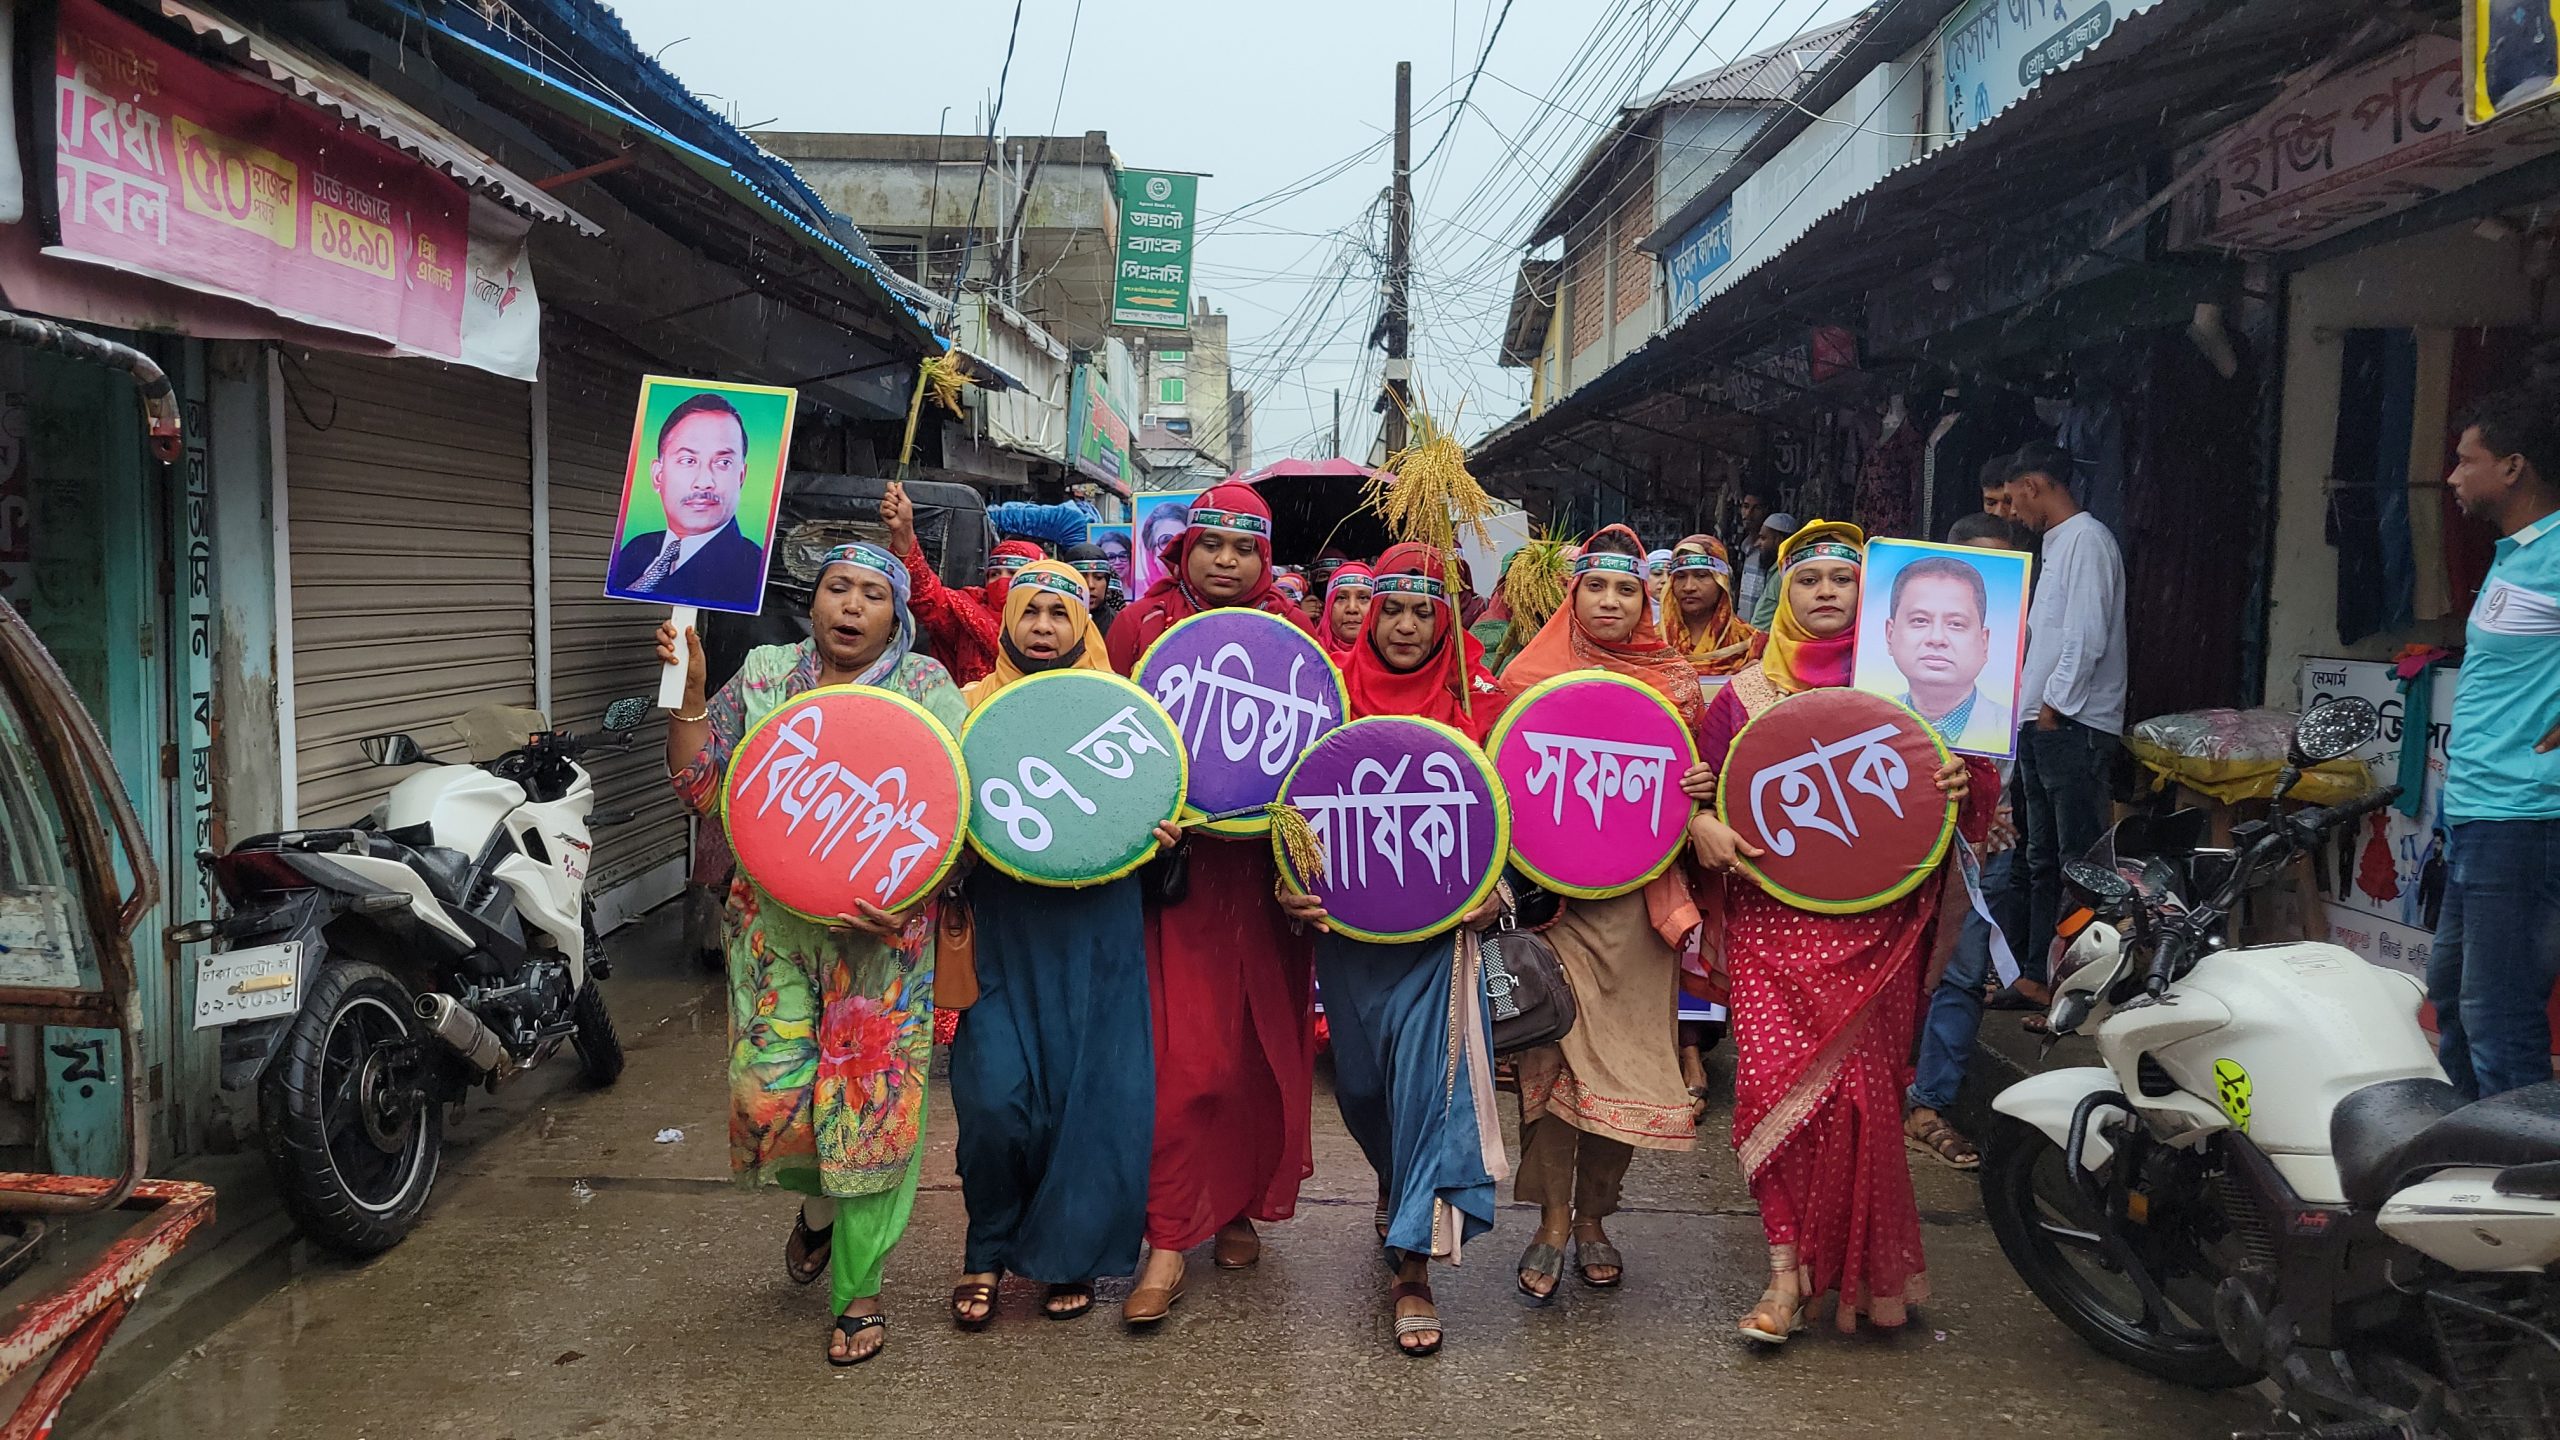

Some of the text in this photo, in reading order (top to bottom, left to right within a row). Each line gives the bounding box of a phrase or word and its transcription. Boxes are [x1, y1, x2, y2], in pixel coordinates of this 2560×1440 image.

[252, 164, 293, 206] হাজার
[346, 187, 391, 225] হাজারে
[1129, 211, 1184, 229] অগ্রণী
[1127, 236, 1182, 254] ব্যাংক
[2312, 667, 2347, 689] মেসার্স
[980, 705, 1172, 852] ৪৭ তম
[1521, 731, 1677, 838] সফল
[1750, 723, 1910, 857] হোক
[736, 705, 940, 906] বিএনপির
[1292, 751, 1479, 893] বার্ষিকী
[203, 967, 231, 982] ঢাকা
